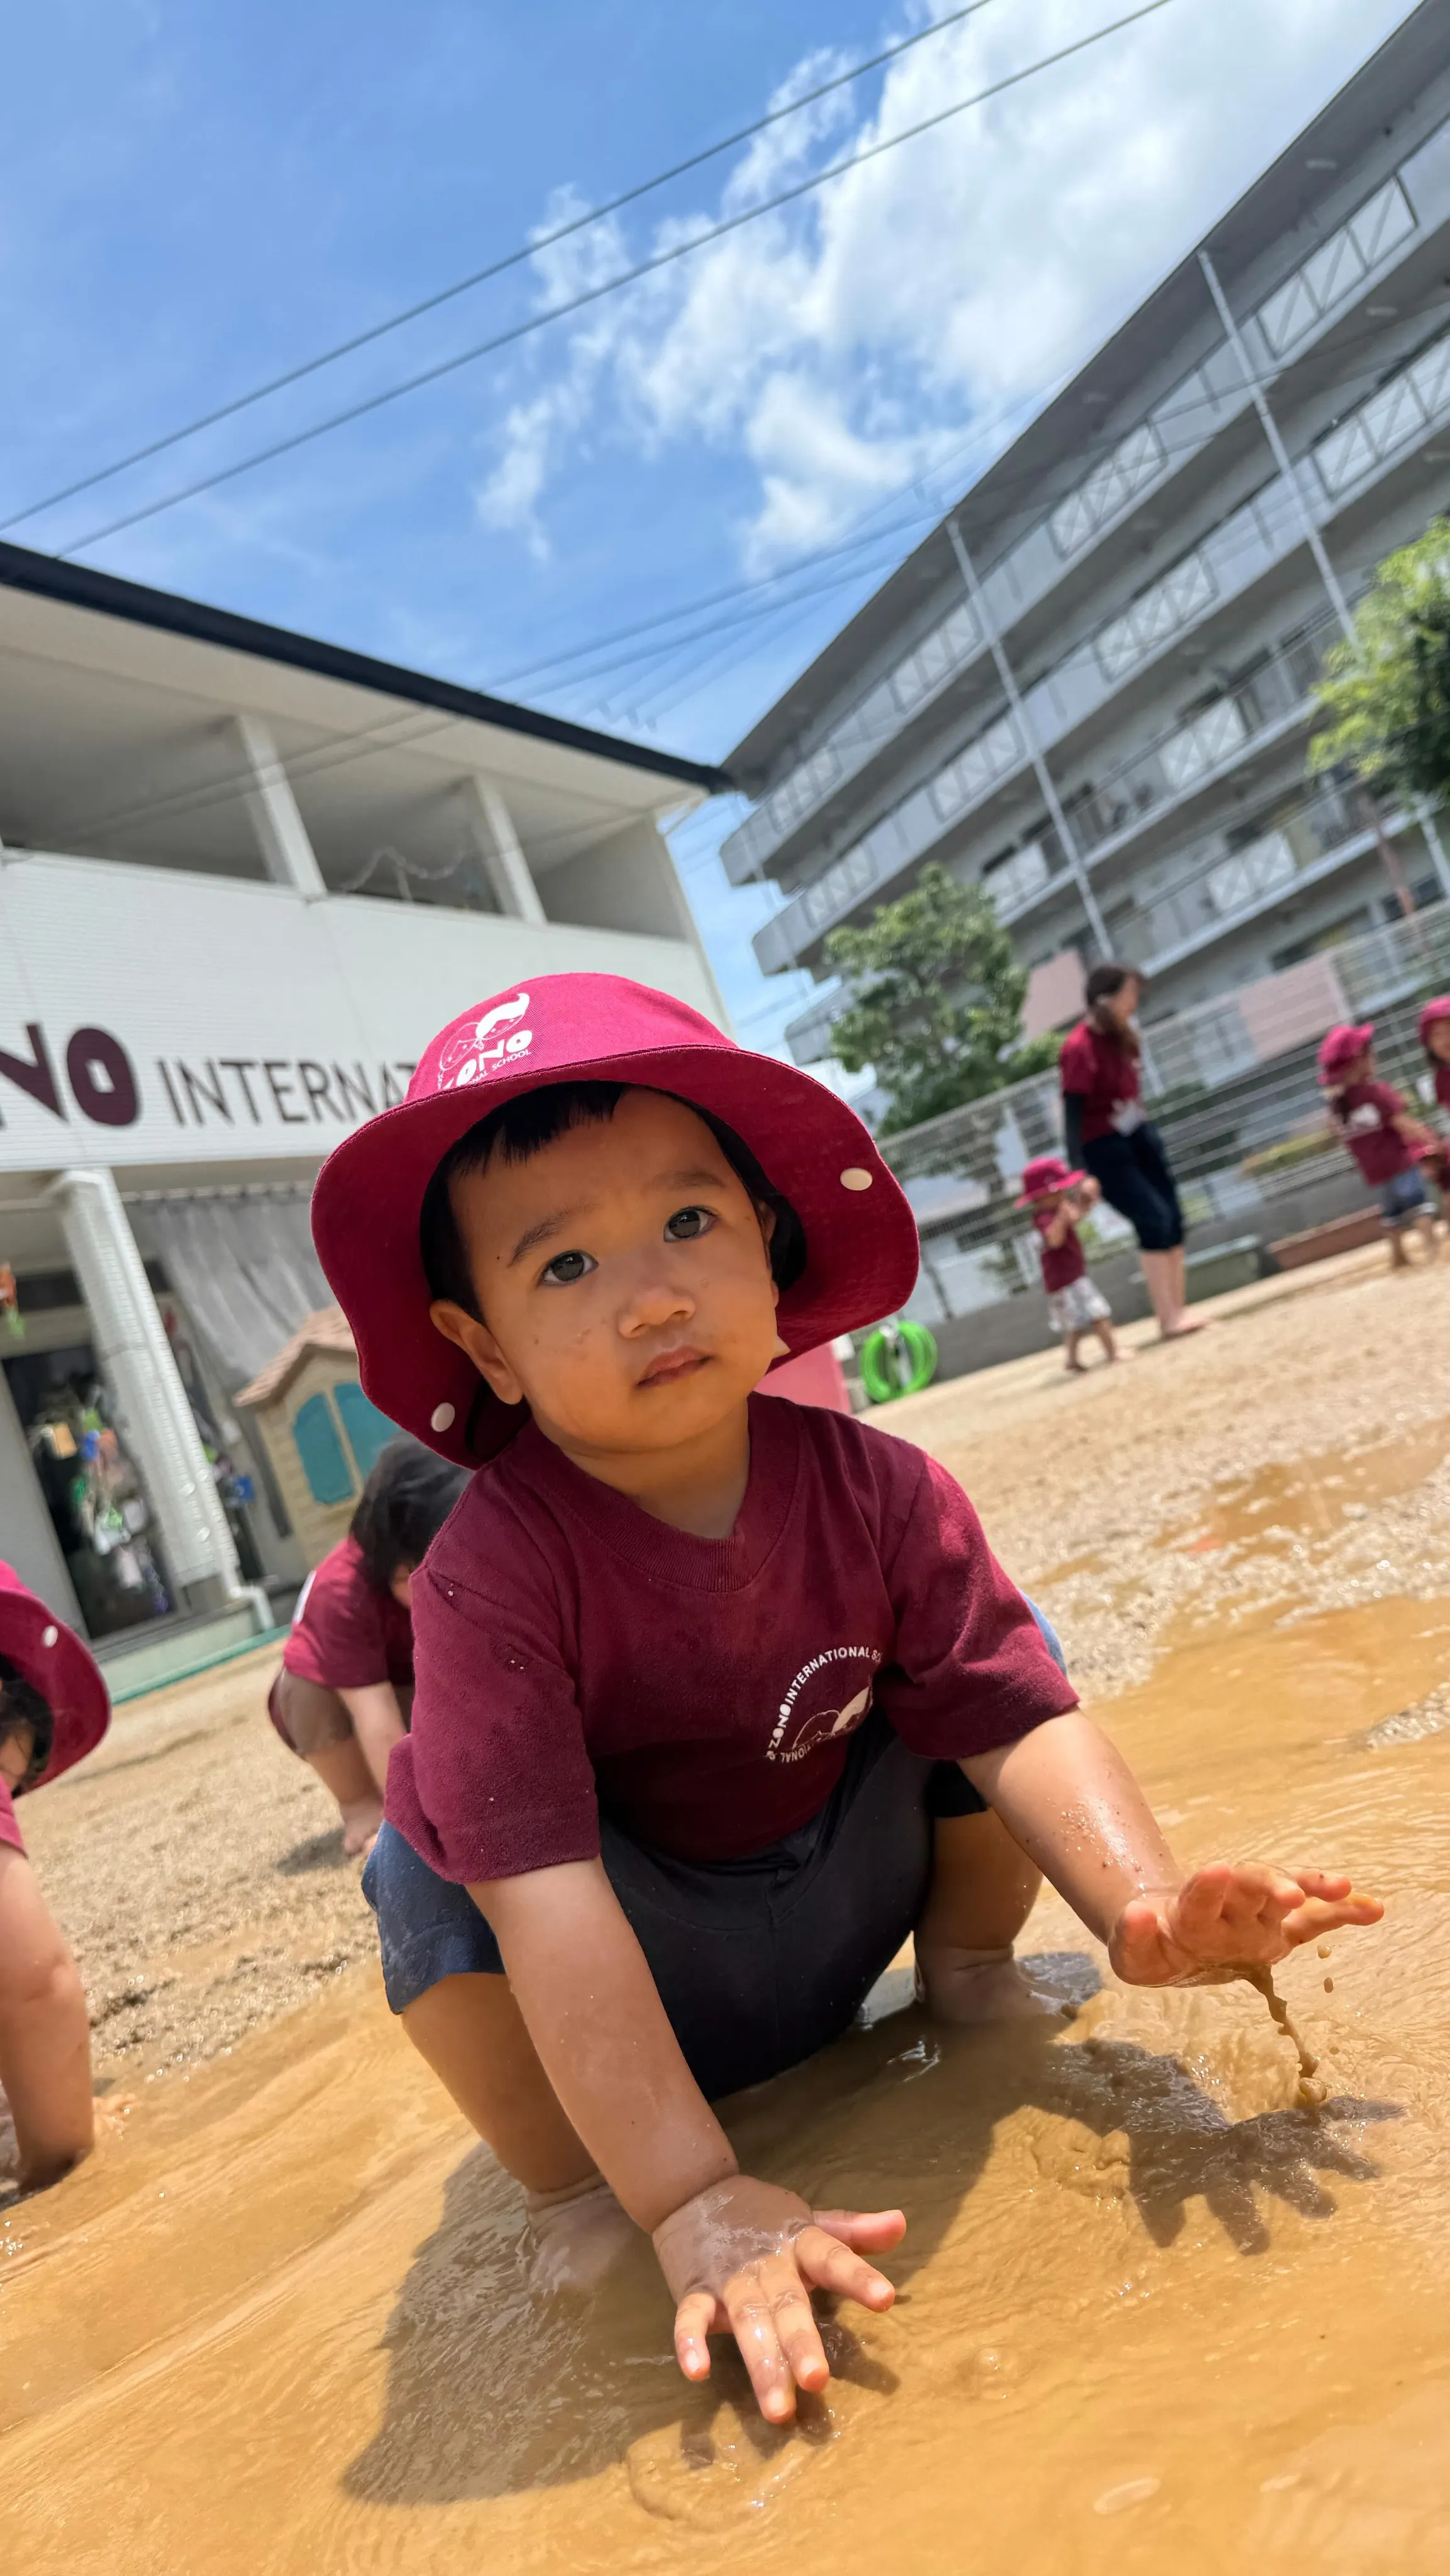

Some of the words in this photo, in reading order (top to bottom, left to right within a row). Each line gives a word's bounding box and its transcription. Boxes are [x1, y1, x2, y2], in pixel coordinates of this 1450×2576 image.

[443, 1030, 533, 1090] ONO
[492, 1049, 532, 1071] SCHOOL
[768, 1703, 792, 1748] ZONO
[784, 1645, 870, 1705] INTERNATIONAL
